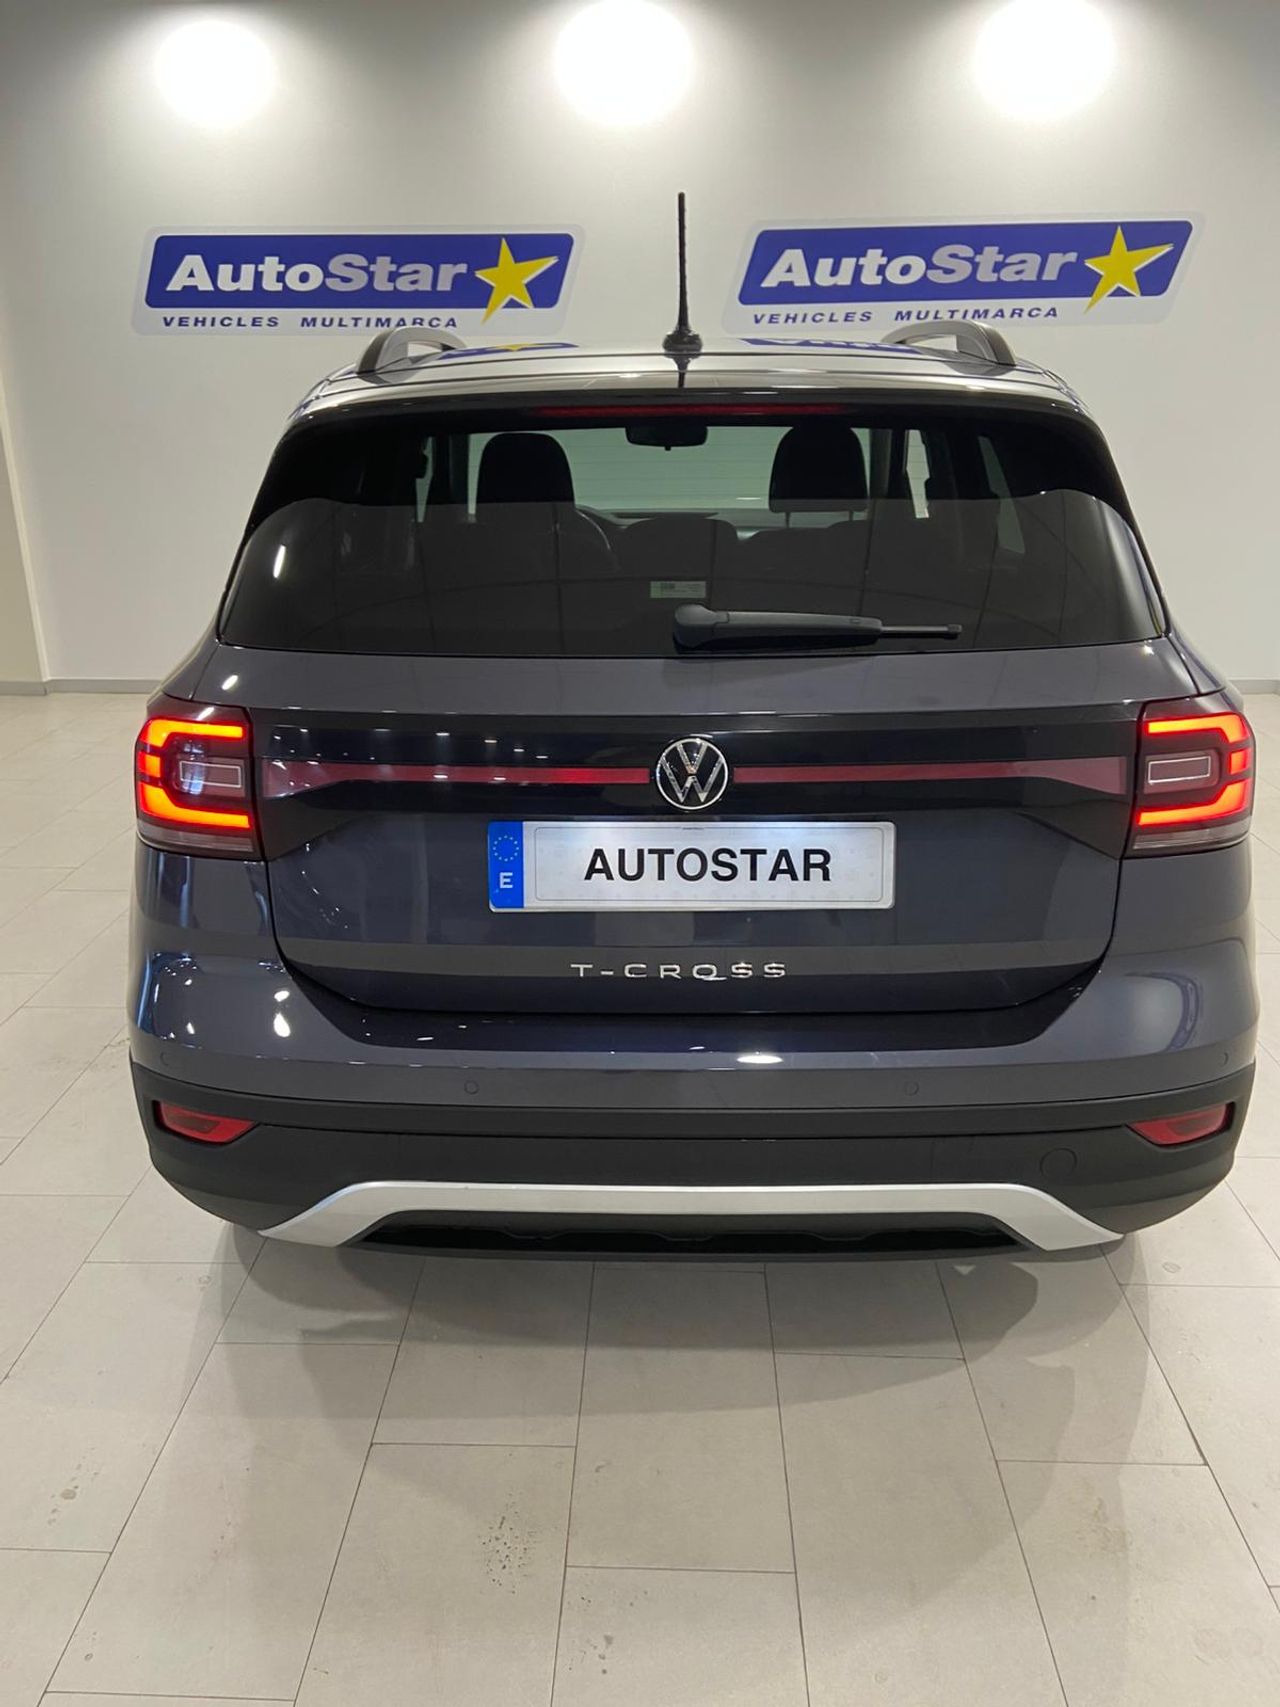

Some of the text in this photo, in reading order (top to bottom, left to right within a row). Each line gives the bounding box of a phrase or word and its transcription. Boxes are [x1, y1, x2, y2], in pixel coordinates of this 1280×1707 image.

[165, 253, 468, 292] AutoStar
[760, 243, 1078, 287] AutoStar
[162, 316, 280, 328] VEHICLES
[752, 307, 1059, 325] VEHICLES MULTIMARCA
[658, 739, 727, 807] VW
[583, 847, 833, 883] AUTOSTAR
[498, 871, 514, 889] E
[570, 963, 786, 980] T-CROSS
